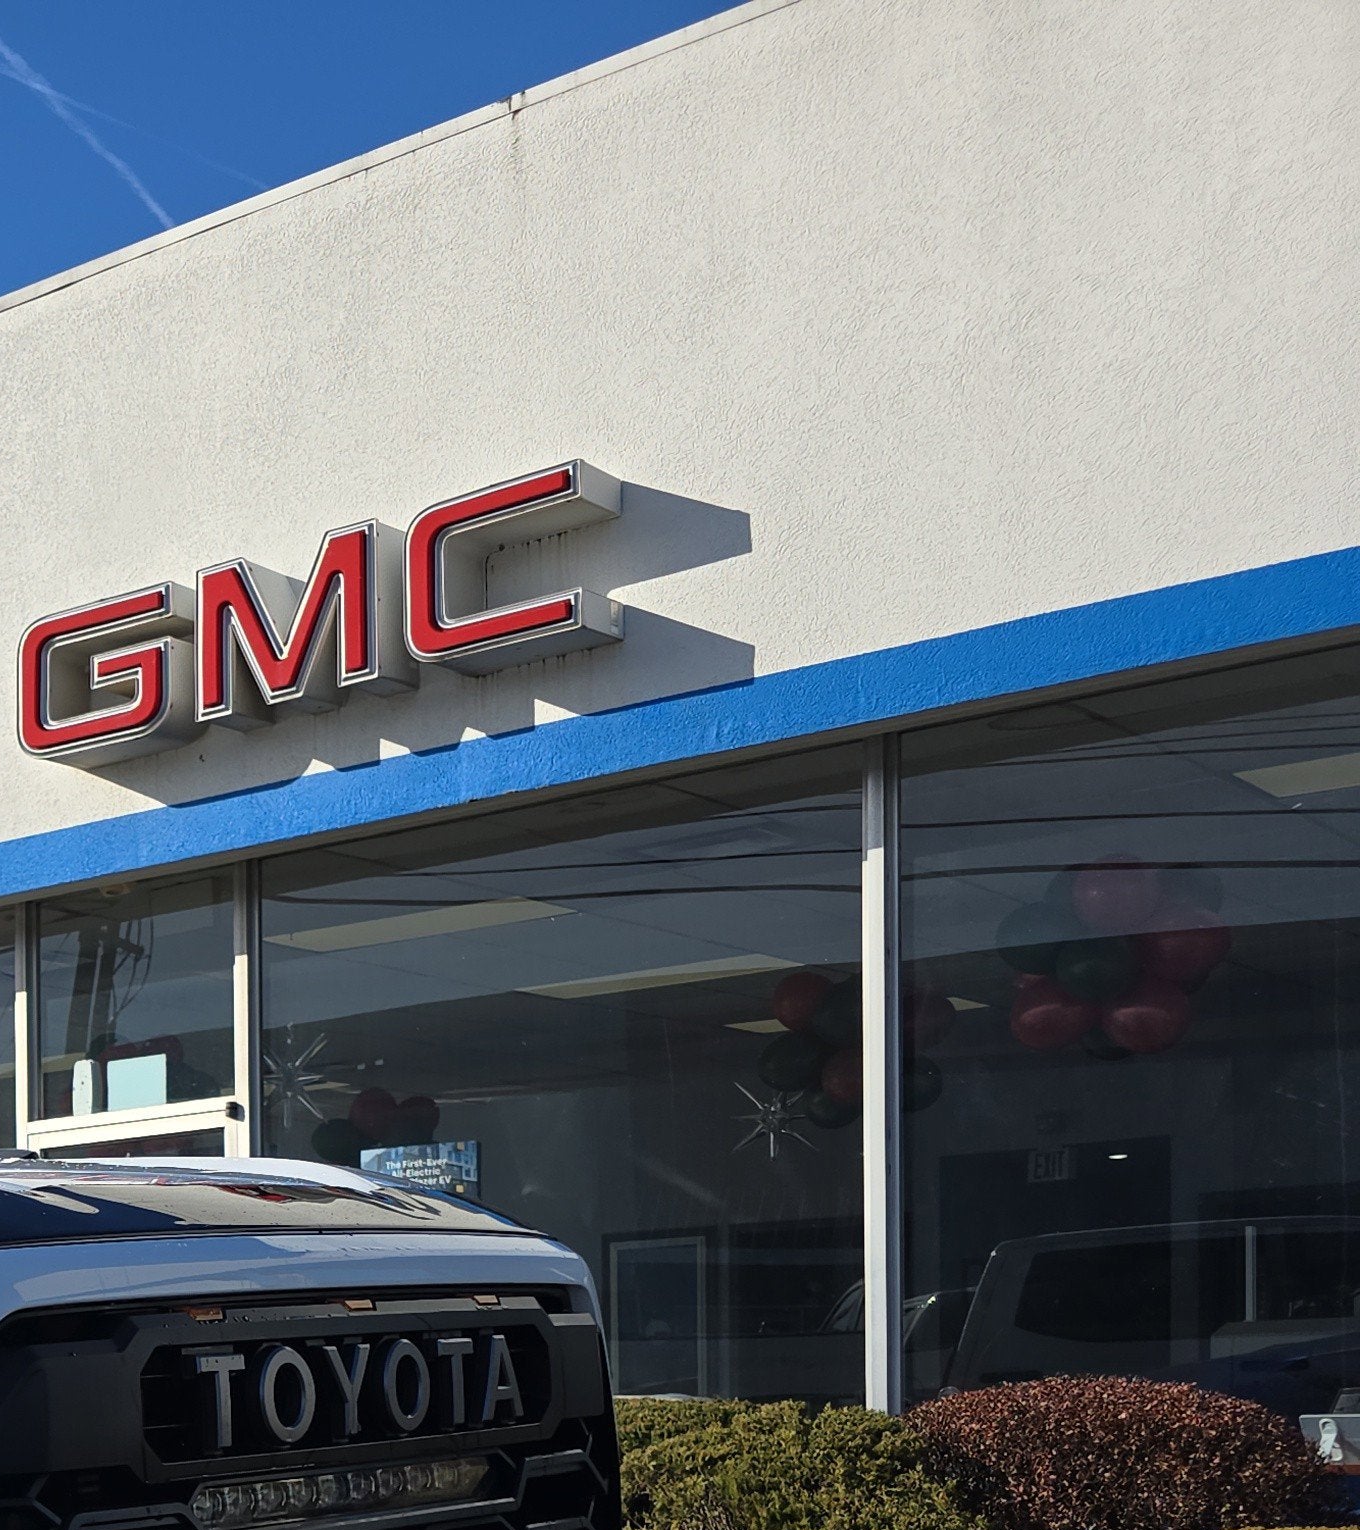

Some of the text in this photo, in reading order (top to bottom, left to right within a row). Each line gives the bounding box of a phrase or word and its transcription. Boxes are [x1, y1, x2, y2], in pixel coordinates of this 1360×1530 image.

[17, 459, 590, 761] GMC
[386, 1158, 447, 1170] The First-Ever
[439, 1175, 452, 1184] EV
[197, 1334, 524, 1449] TOYOTA
